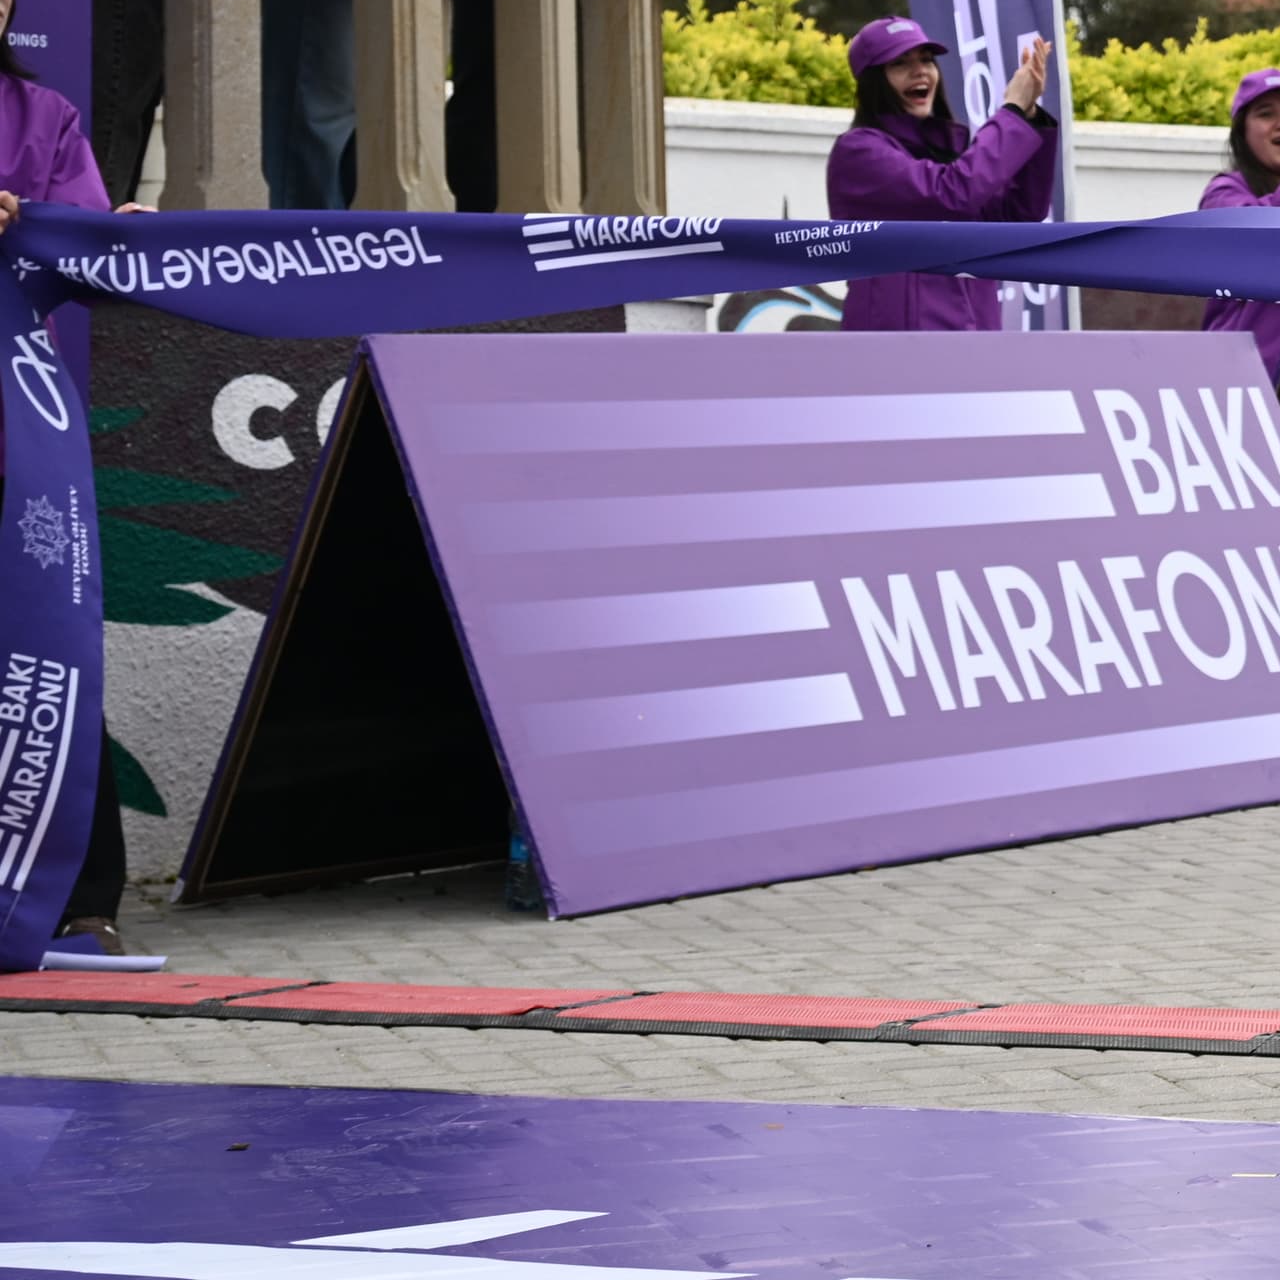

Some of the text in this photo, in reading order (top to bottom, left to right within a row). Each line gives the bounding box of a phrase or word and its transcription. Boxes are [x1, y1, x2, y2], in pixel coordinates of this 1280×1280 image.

[775, 226, 829, 244] HEYDƏR
[806, 240, 851, 258] FONDU
[0, 652, 38, 723] BAKI
[1, 659, 66, 829] MARAFONU
